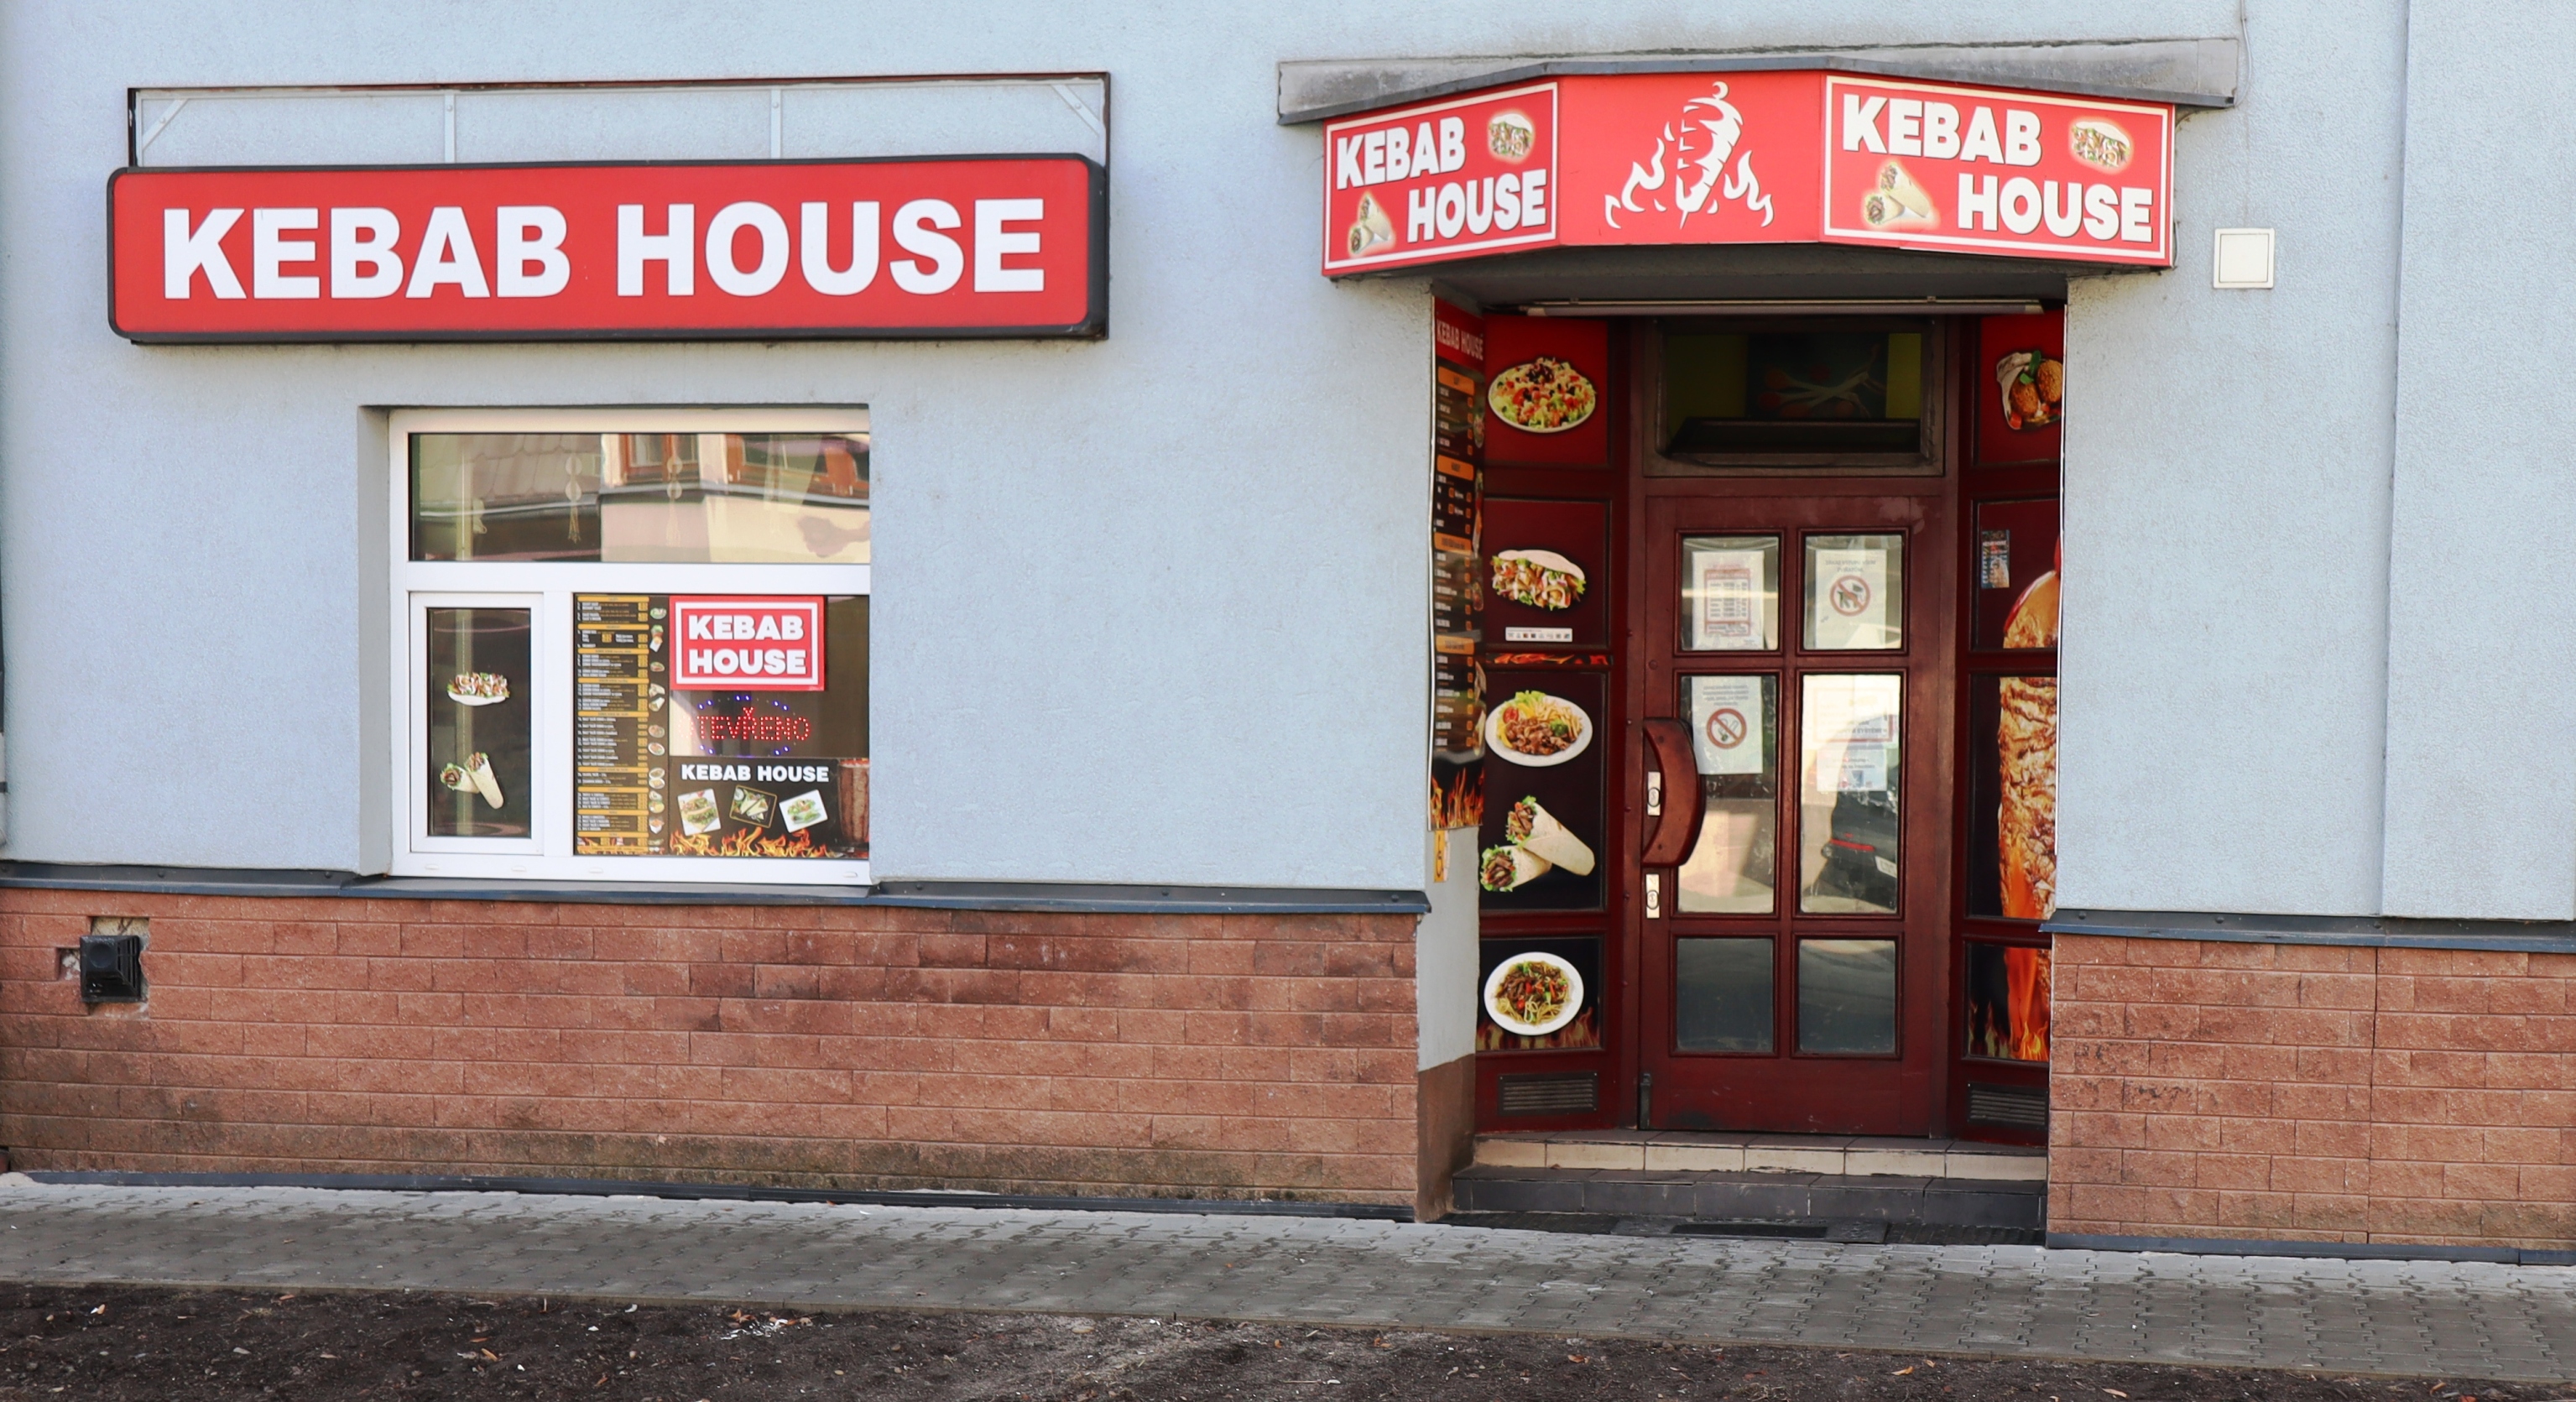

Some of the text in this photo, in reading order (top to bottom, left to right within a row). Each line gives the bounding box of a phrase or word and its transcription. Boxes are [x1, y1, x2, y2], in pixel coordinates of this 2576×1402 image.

[1337, 116, 1467, 190] KEBAB
[1842, 93, 2042, 167] KEBAB
[1406, 168, 1547, 243] HOUSE
[1957, 172, 2154, 243] HOUSE
[163, 197, 1046, 300] KEBAB HOUSE
[1437, 319, 1484, 361] KEBAB HOUSE
[688, 614, 805, 641] KEBAB
[688, 648, 807, 675] HOUSE
[681, 764, 830, 783] KEBAB HOUSE
